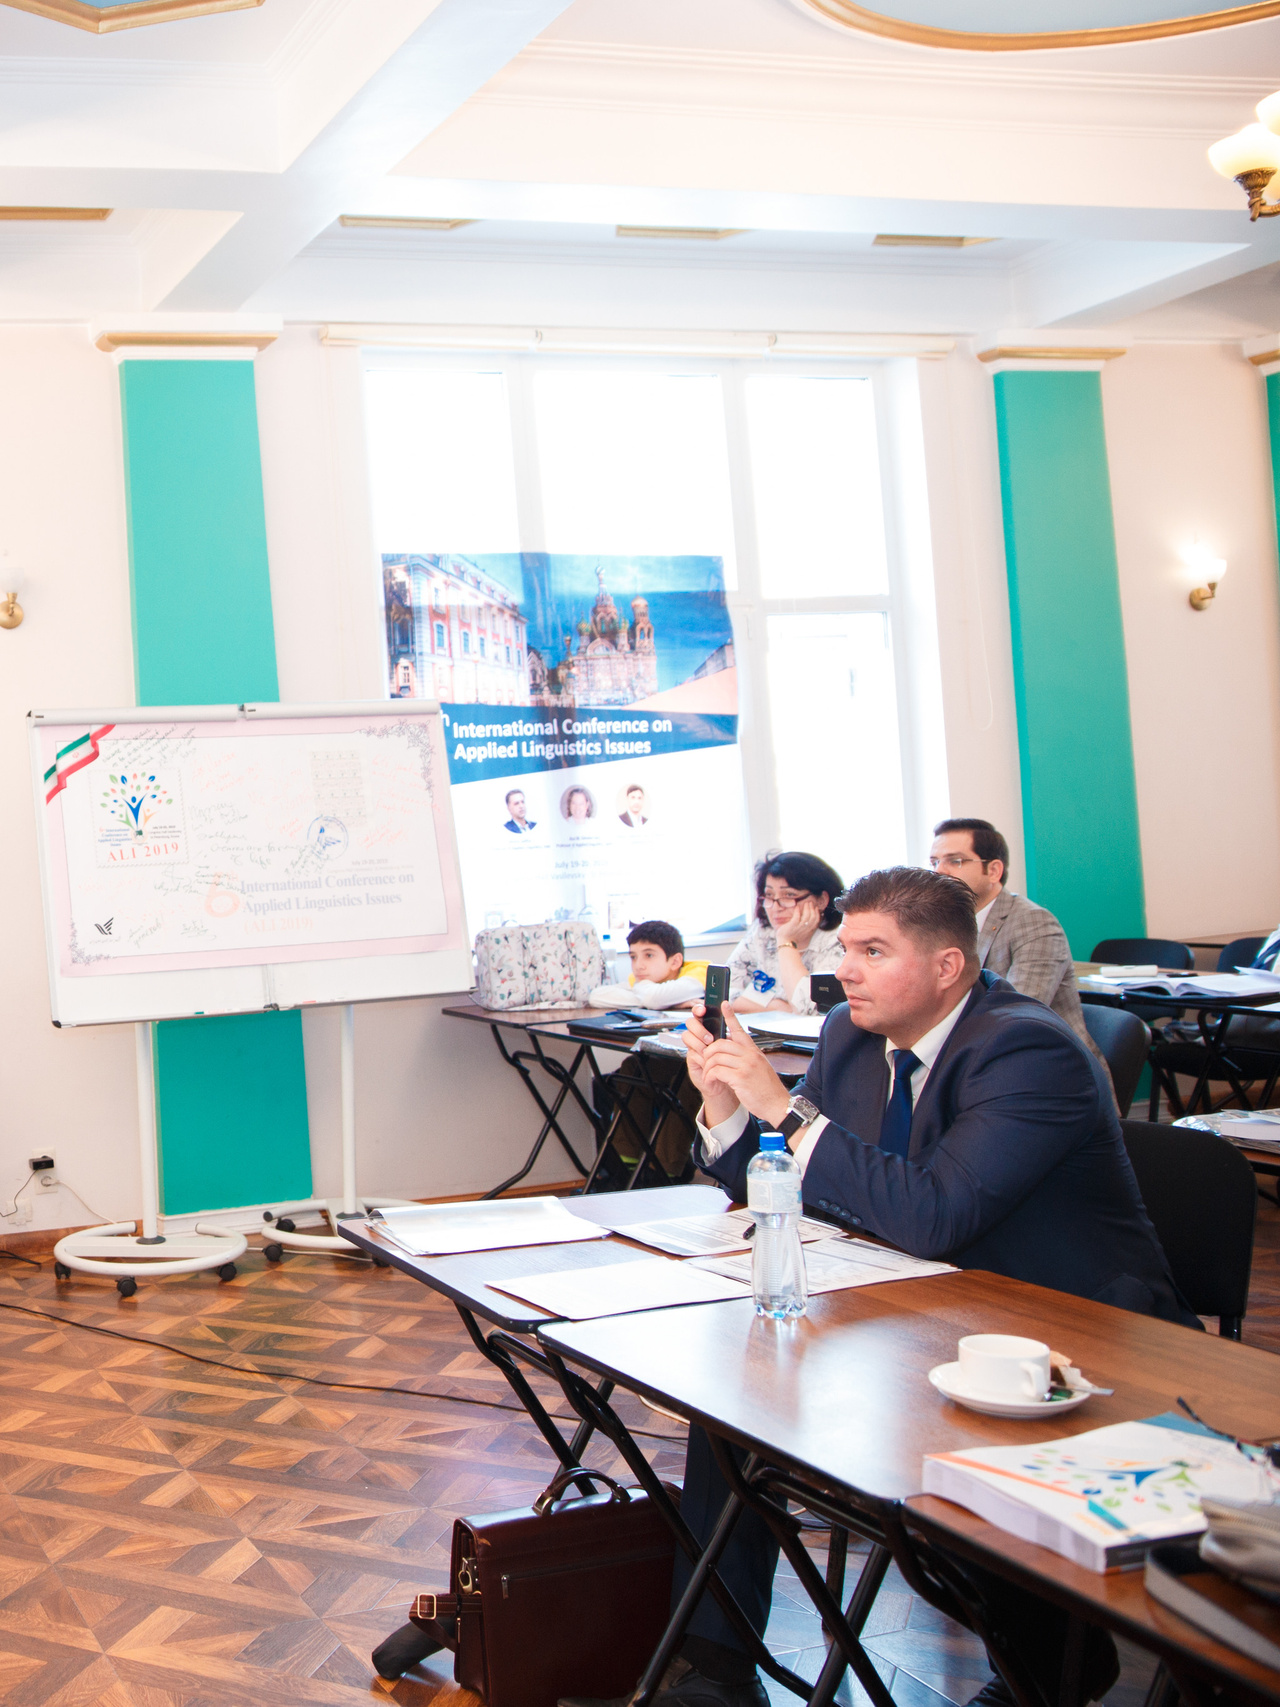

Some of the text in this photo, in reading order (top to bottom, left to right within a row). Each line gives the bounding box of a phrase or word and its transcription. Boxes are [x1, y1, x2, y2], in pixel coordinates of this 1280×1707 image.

[453, 717, 673, 739] International Conference on
[453, 738, 651, 763] Applied Linguistics Issues
[108, 841, 179, 862] ALI 2019
[241, 876, 323, 894] International
[325, 873, 398, 889] Conference
[400, 872, 415, 884] on
[243, 892, 402, 916] Applied Linguistics Issues
[243, 916, 314, 935] (ALI 2019)
